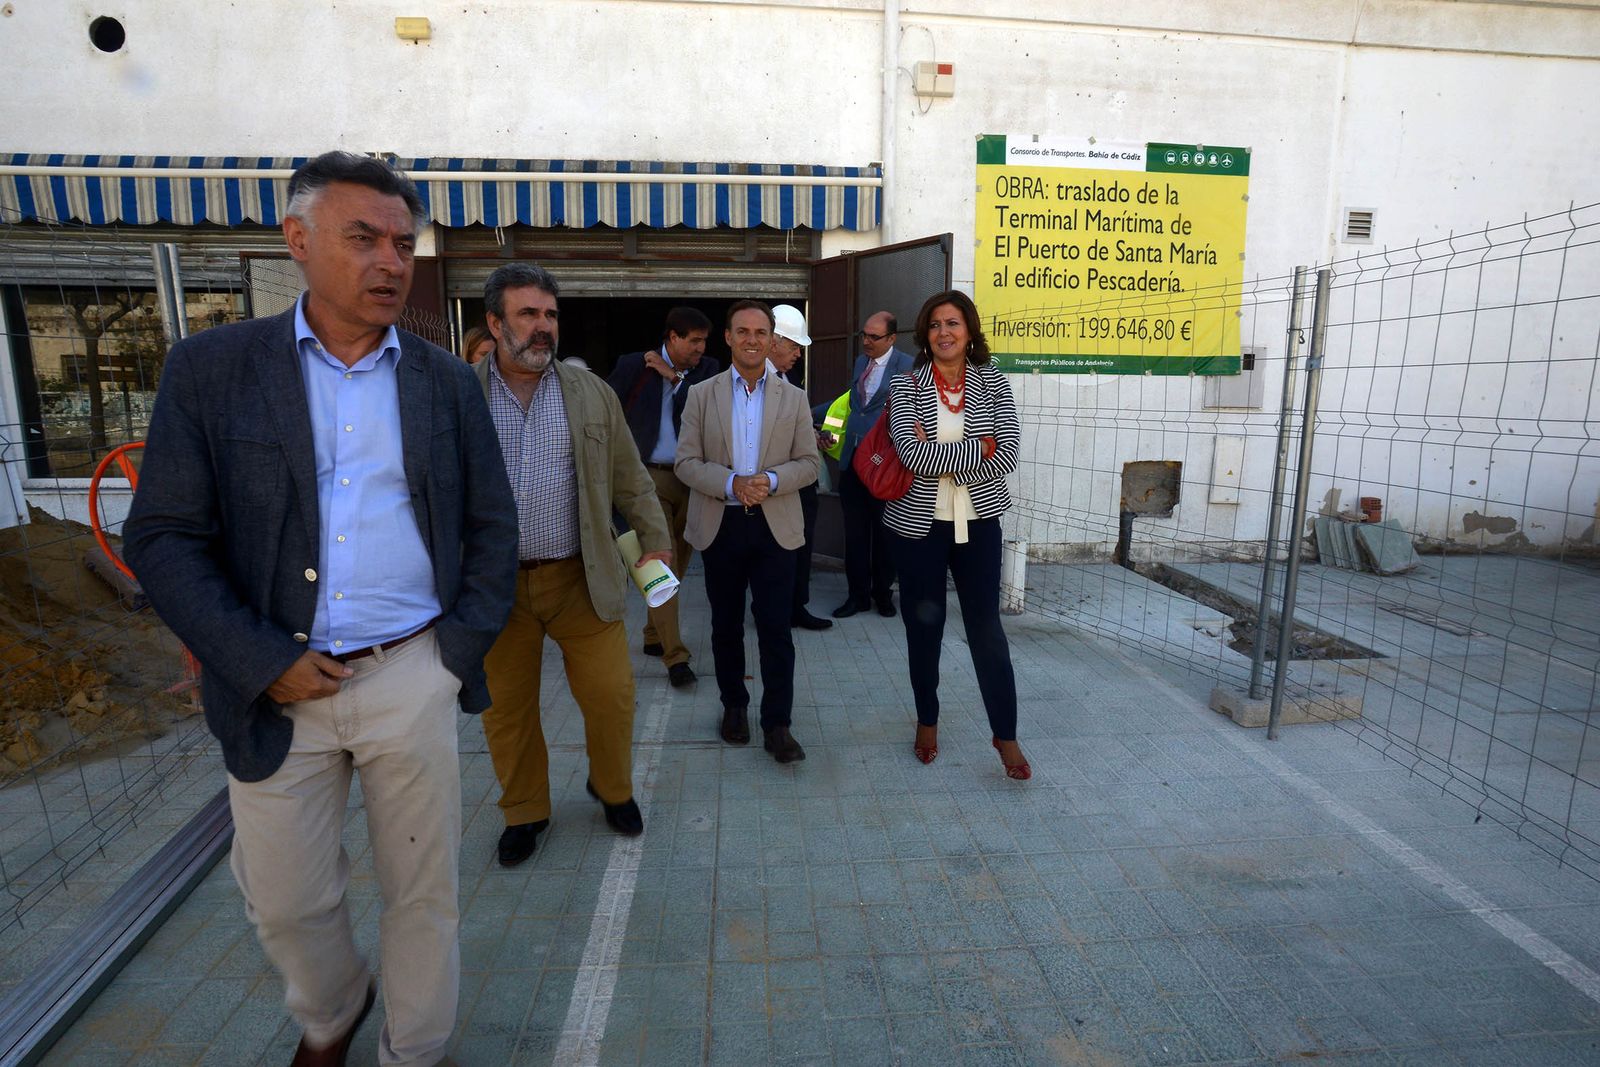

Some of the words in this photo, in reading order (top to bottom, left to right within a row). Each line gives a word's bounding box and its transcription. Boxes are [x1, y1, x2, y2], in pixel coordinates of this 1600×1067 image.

[1010, 146, 1041, 155] Consorcio
[1041, 148, 1050, 156] de
[1088, 150, 1109, 159] Bahía
[1111, 152, 1120, 160] de
[1121, 152, 1141, 161] Cádiz
[995, 175, 1049, 200] OBRA:
[1056, 179, 1130, 203] traslado
[1136, 181, 1159, 205] de
[1165, 183, 1180, 206] la
[995, 205, 1078, 231] Terminal
[1085, 208, 1164, 235] Marítima
[1170, 212, 1192, 236] de
[995, 235, 1011, 258] El
[1018, 235, 1080, 260] Puerto
[1087, 238, 1109, 262] de
[1115, 239, 1163, 264] Santa
[1169, 242, 1218, 266] María
[993, 265, 1008, 287] al
[1014, 266, 1080, 290] edificio
[1087, 267, 1185, 293] Pescadería.
[992, 315, 1071, 338] Inversión:
[1079, 317, 1175, 343] 199.646,80
[1180, 320, 1192, 341] €
[1015, 359, 1049, 368] Transportes
[1050, 359, 1075, 367] Públicos
